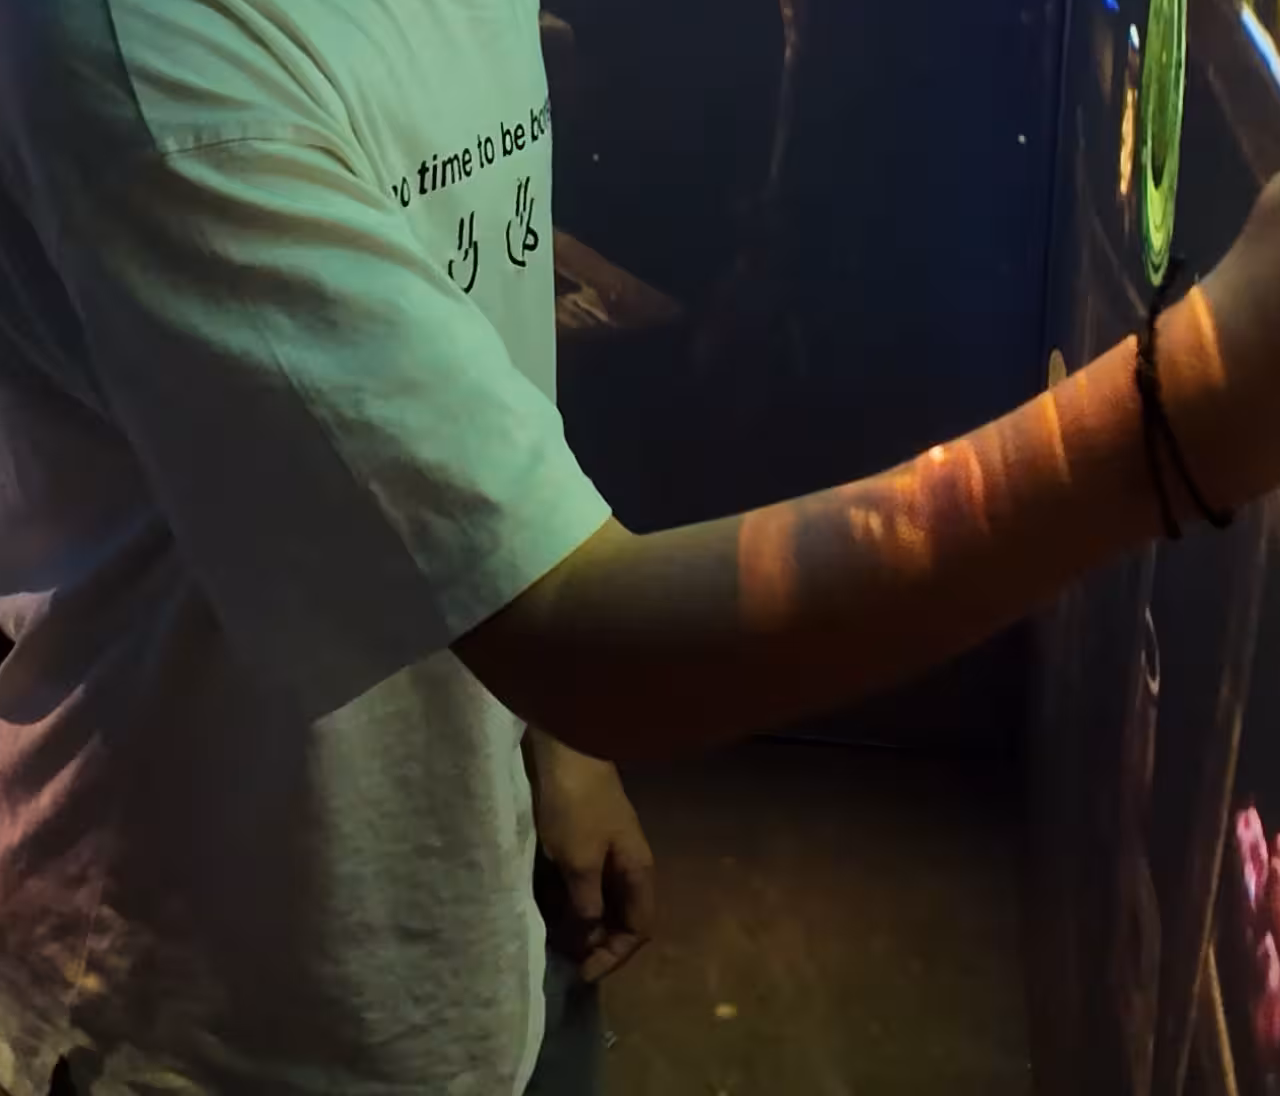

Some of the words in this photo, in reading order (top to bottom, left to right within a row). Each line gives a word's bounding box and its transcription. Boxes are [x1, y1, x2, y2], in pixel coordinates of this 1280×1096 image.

[391, 176, 411, 208] o
[417, 147, 473, 195] time
[477, 133, 495, 169] to
[500, 121, 526, 158] be
